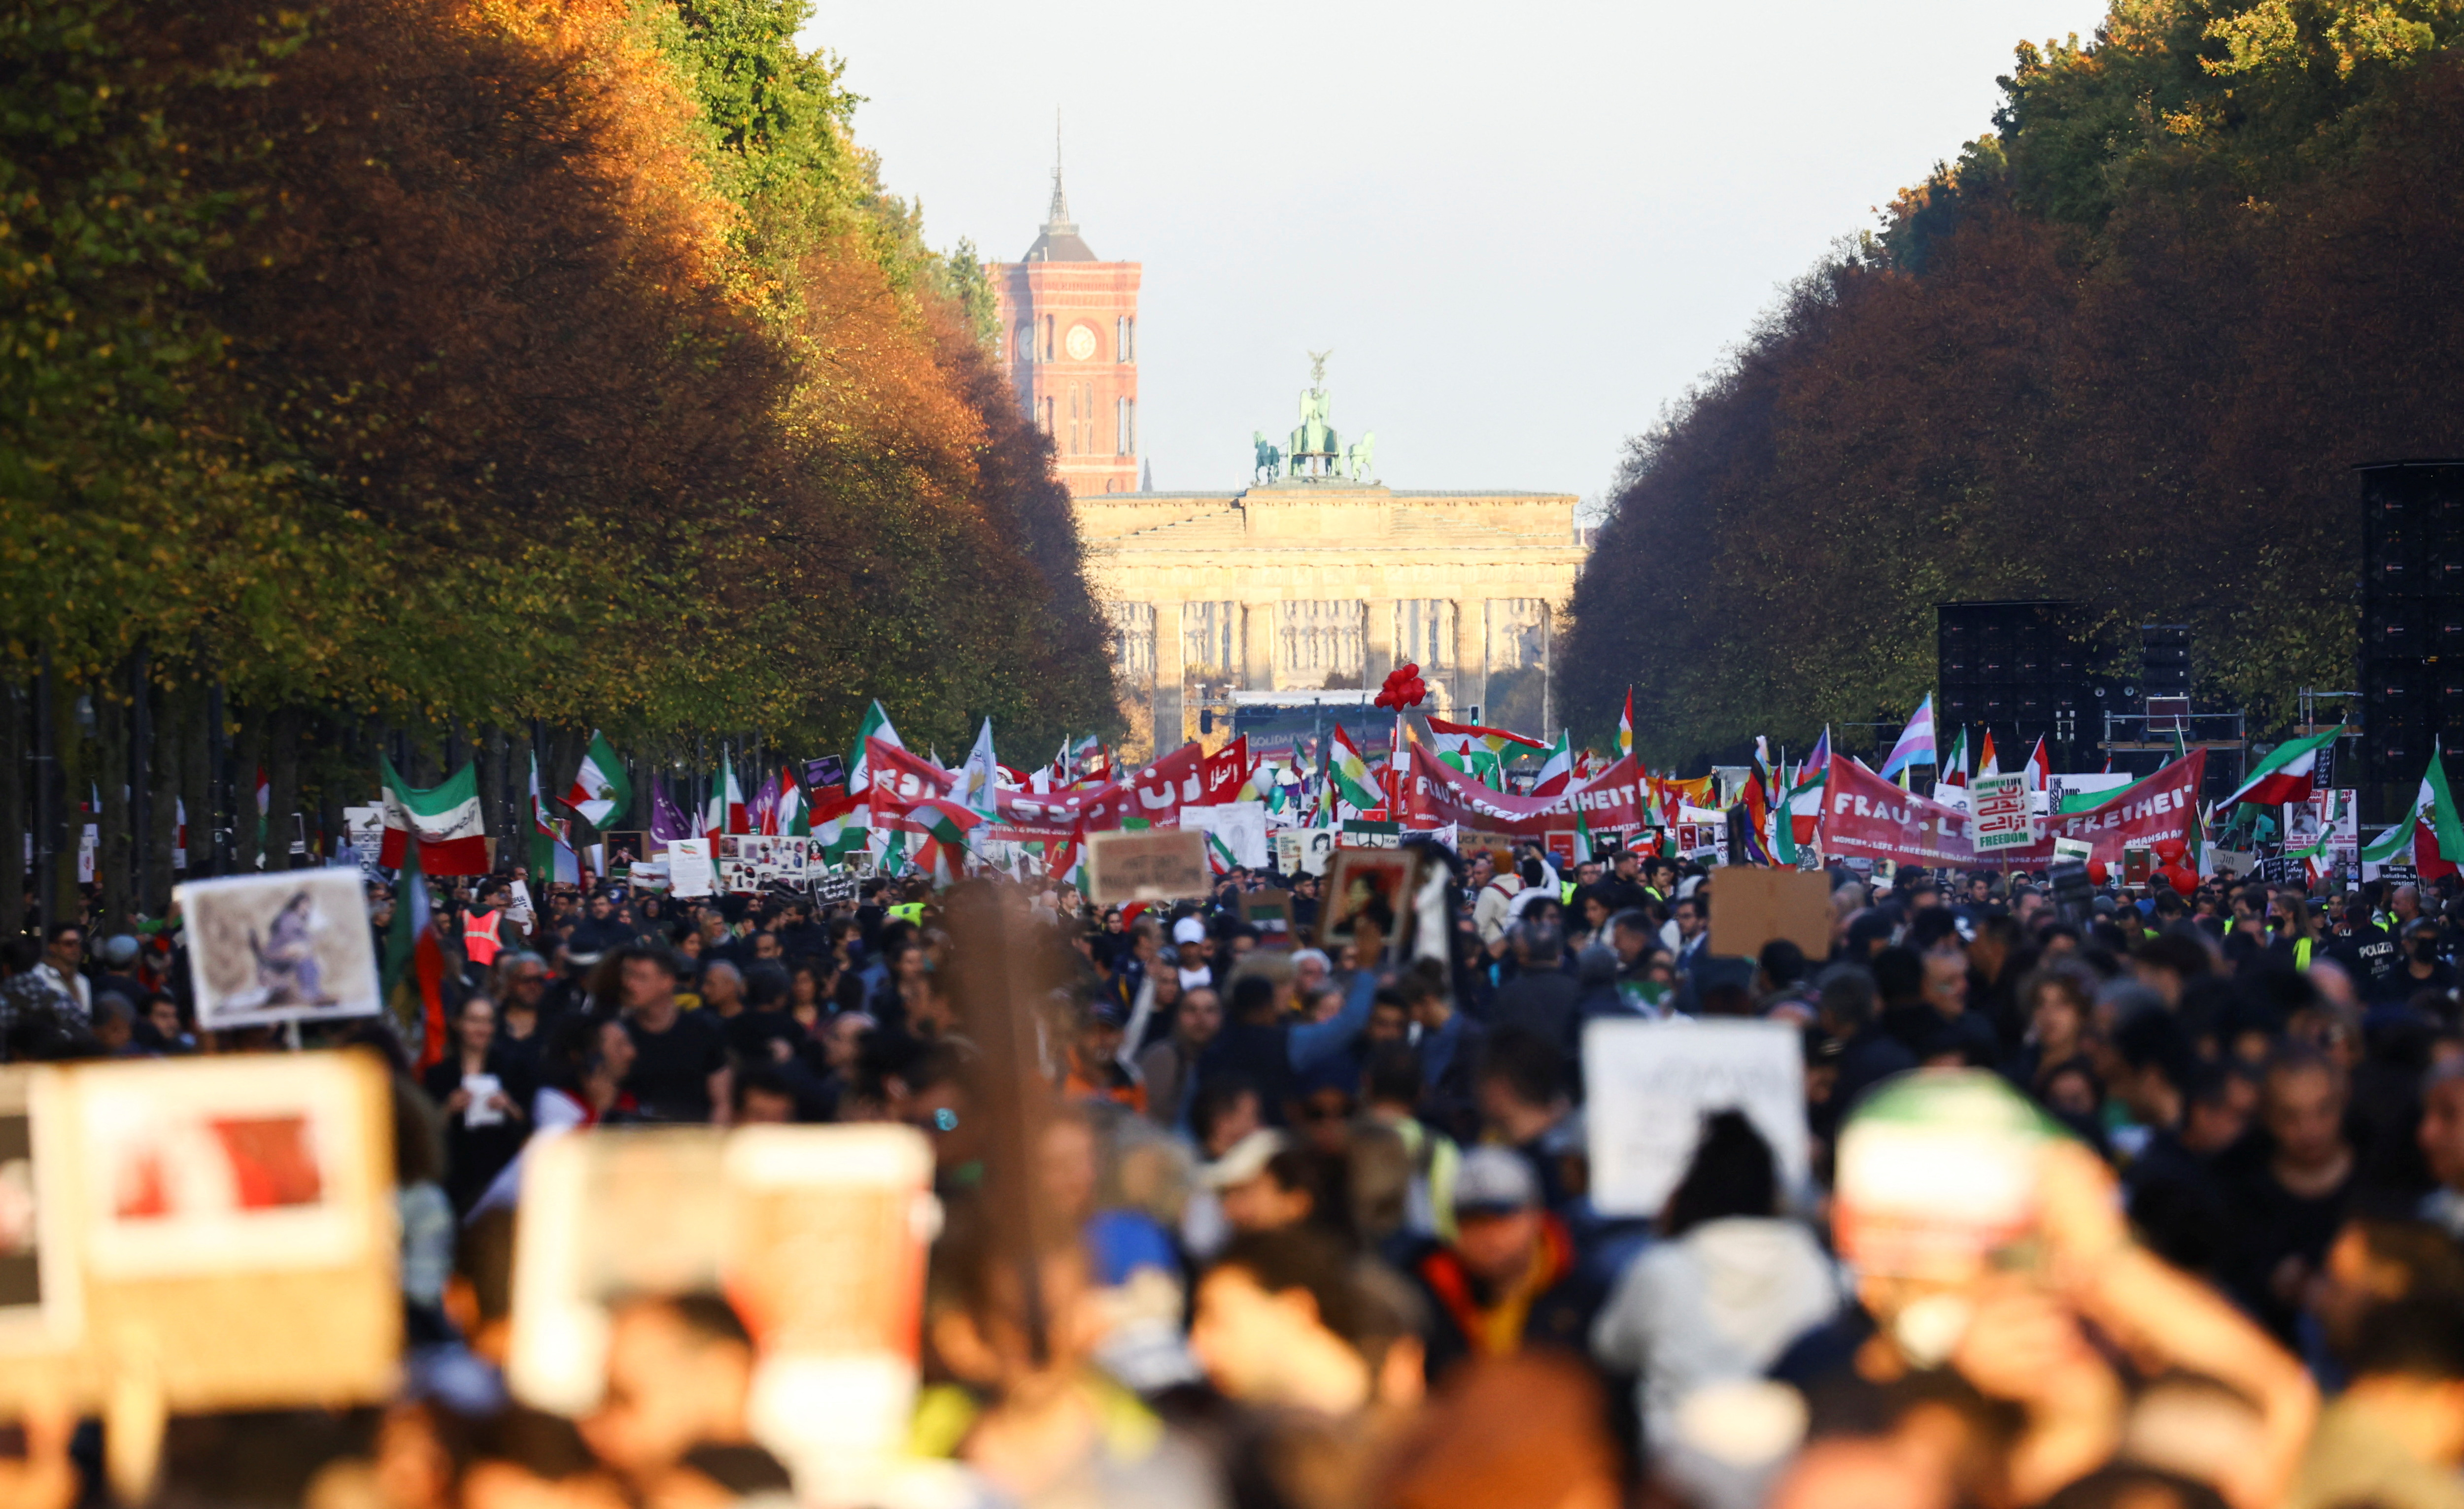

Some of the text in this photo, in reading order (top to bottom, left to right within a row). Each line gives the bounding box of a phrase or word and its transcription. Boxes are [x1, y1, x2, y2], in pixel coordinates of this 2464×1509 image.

[2066, 784, 2193, 837] FREIHEIT
[1980, 832, 2028, 847] FREEDOM
[1872, 841, 1893, 851] LIFE
[1899, 845, 1940, 858] FREEDOM
